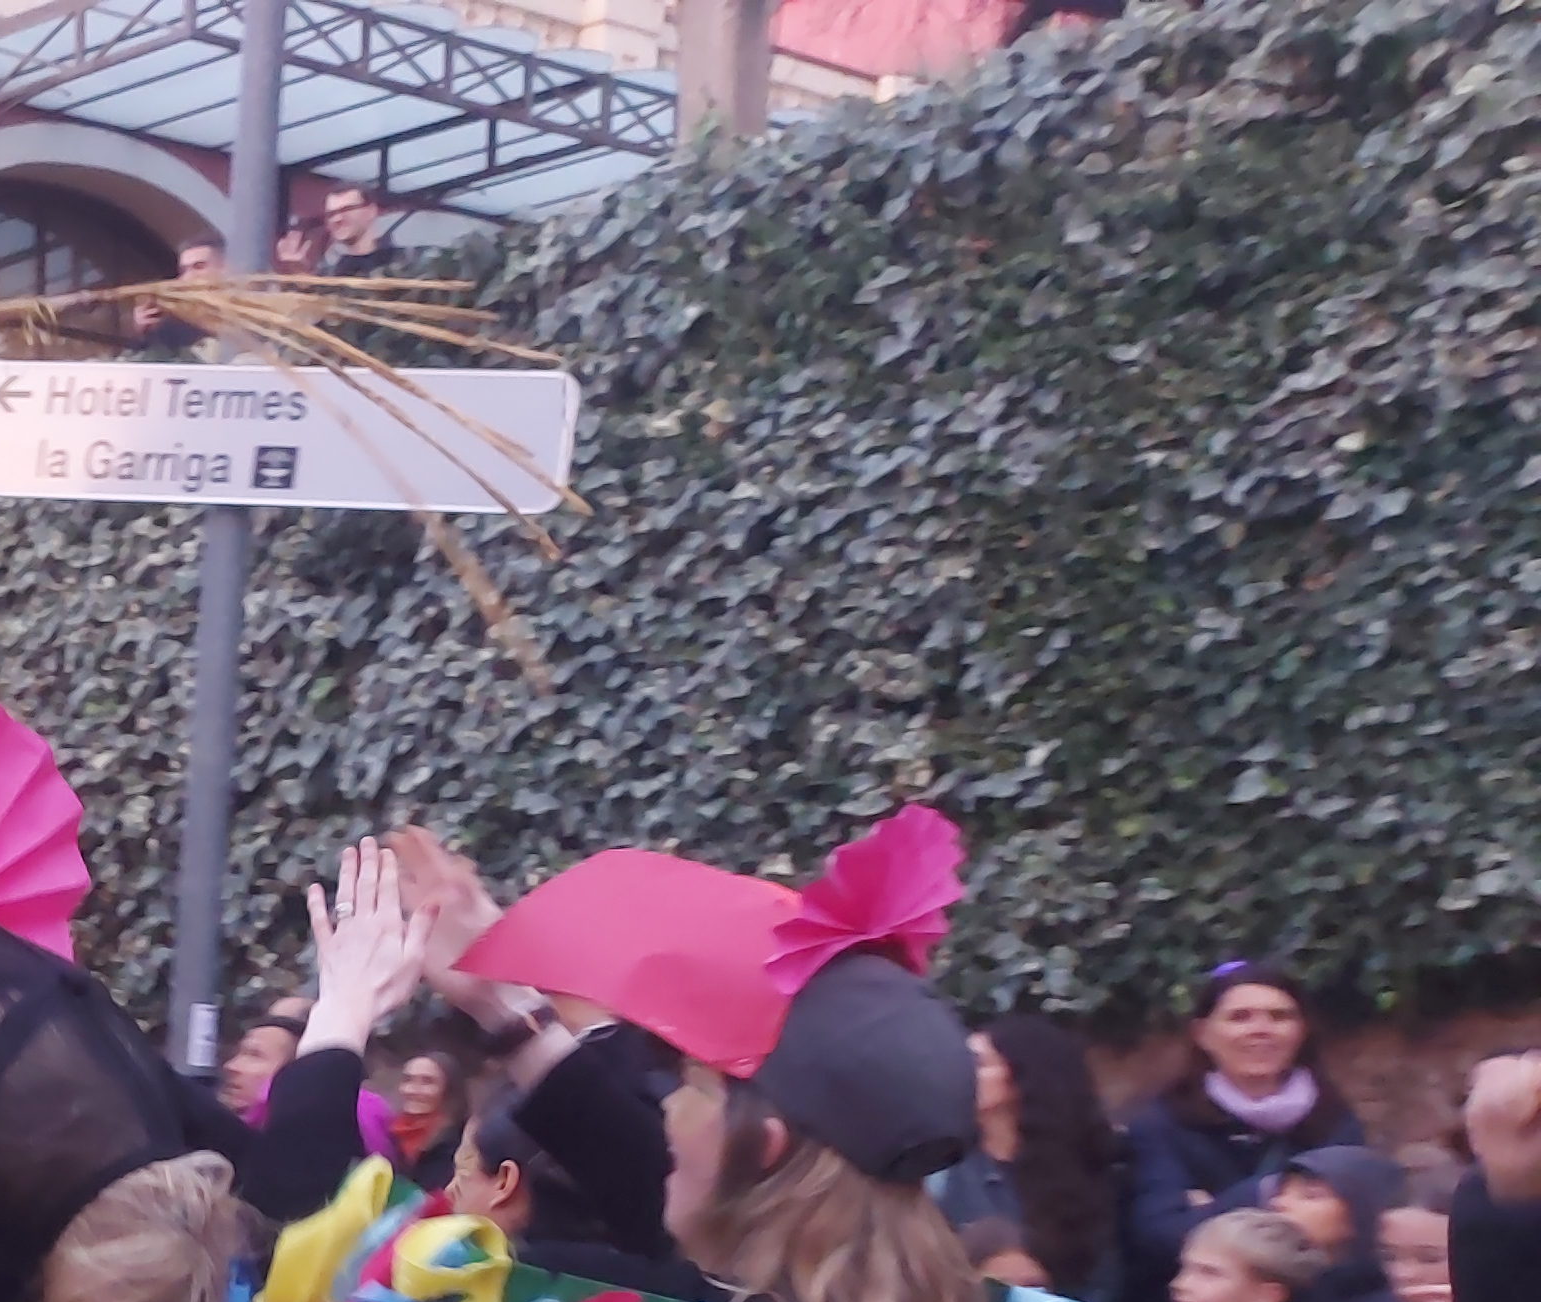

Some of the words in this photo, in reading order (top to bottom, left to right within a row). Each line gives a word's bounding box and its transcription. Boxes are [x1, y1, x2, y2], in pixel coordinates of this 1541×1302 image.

[44, 375, 151, 416] Hotel
[164, 378, 307, 420] Termes
[36, 440, 67, 478] la
[84, 440, 230, 493] Garriga
